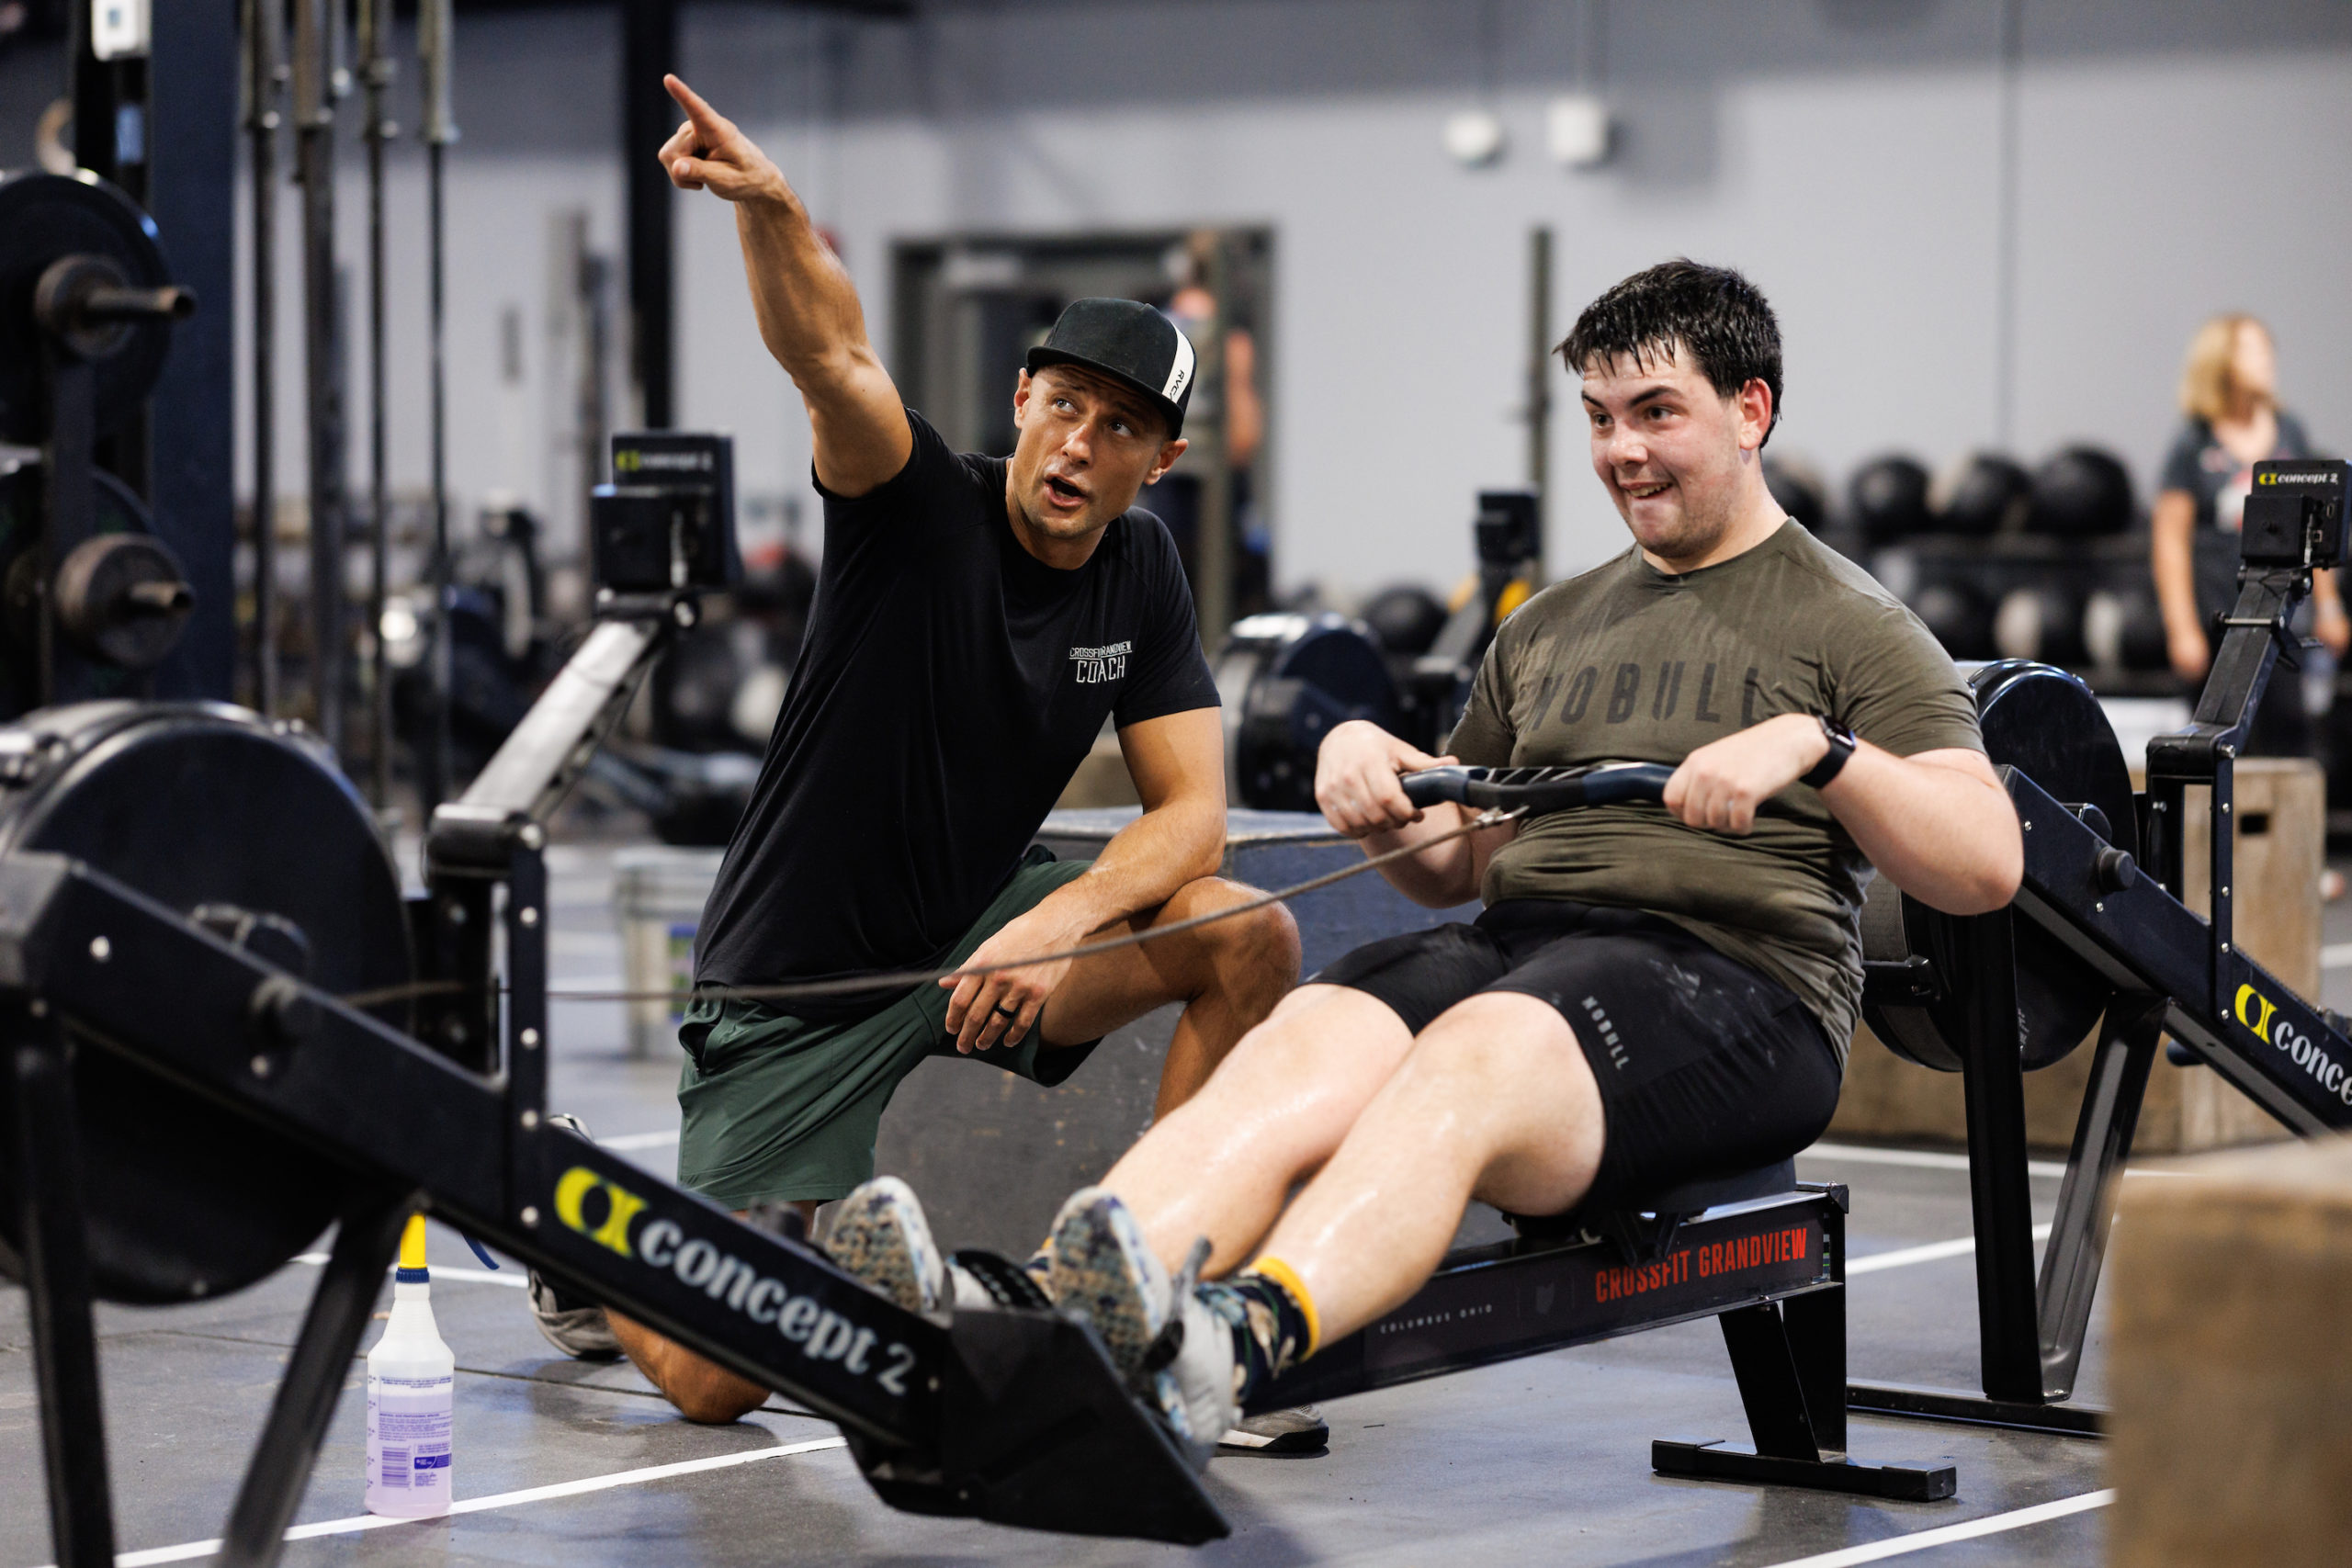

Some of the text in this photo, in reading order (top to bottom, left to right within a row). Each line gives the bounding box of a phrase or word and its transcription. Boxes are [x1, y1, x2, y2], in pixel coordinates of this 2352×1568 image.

[2278, 473, 2338, 485] concept 2
[1076, 655, 1125, 683] COACH
[1581, 996, 1630, 1070] NOBULL
[1596, 1227, 1807, 1303] CROSSFIT GRANDVIEW
[639, 1219, 916, 1396] concept 2
